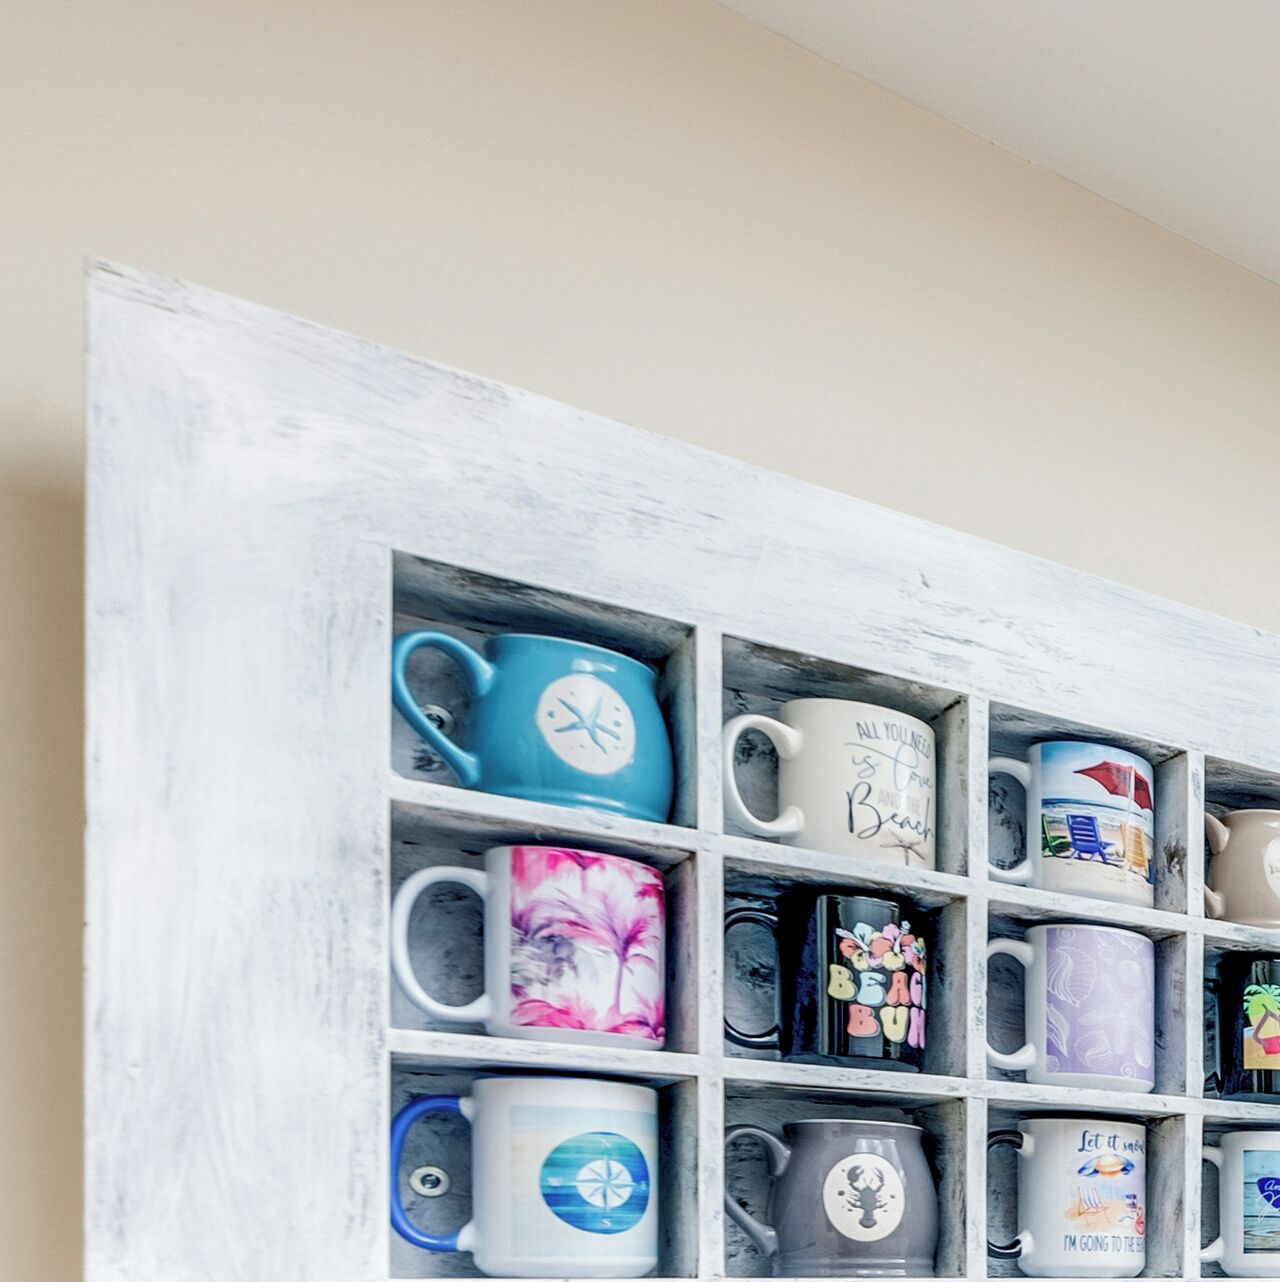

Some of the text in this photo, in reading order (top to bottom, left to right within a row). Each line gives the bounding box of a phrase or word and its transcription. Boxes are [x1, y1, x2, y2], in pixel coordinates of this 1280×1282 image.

[856, 721, 882, 740] ALL
[883, 722, 908, 743] YOU
[846, 781, 934, 842] Beach
[1078, 1130, 1105, 1152] Let
[1107, 1134, 1120, 1151] it
[1080, 1235, 1109, 1251] GOING
[1111, 1235, 1121, 1252] TO
